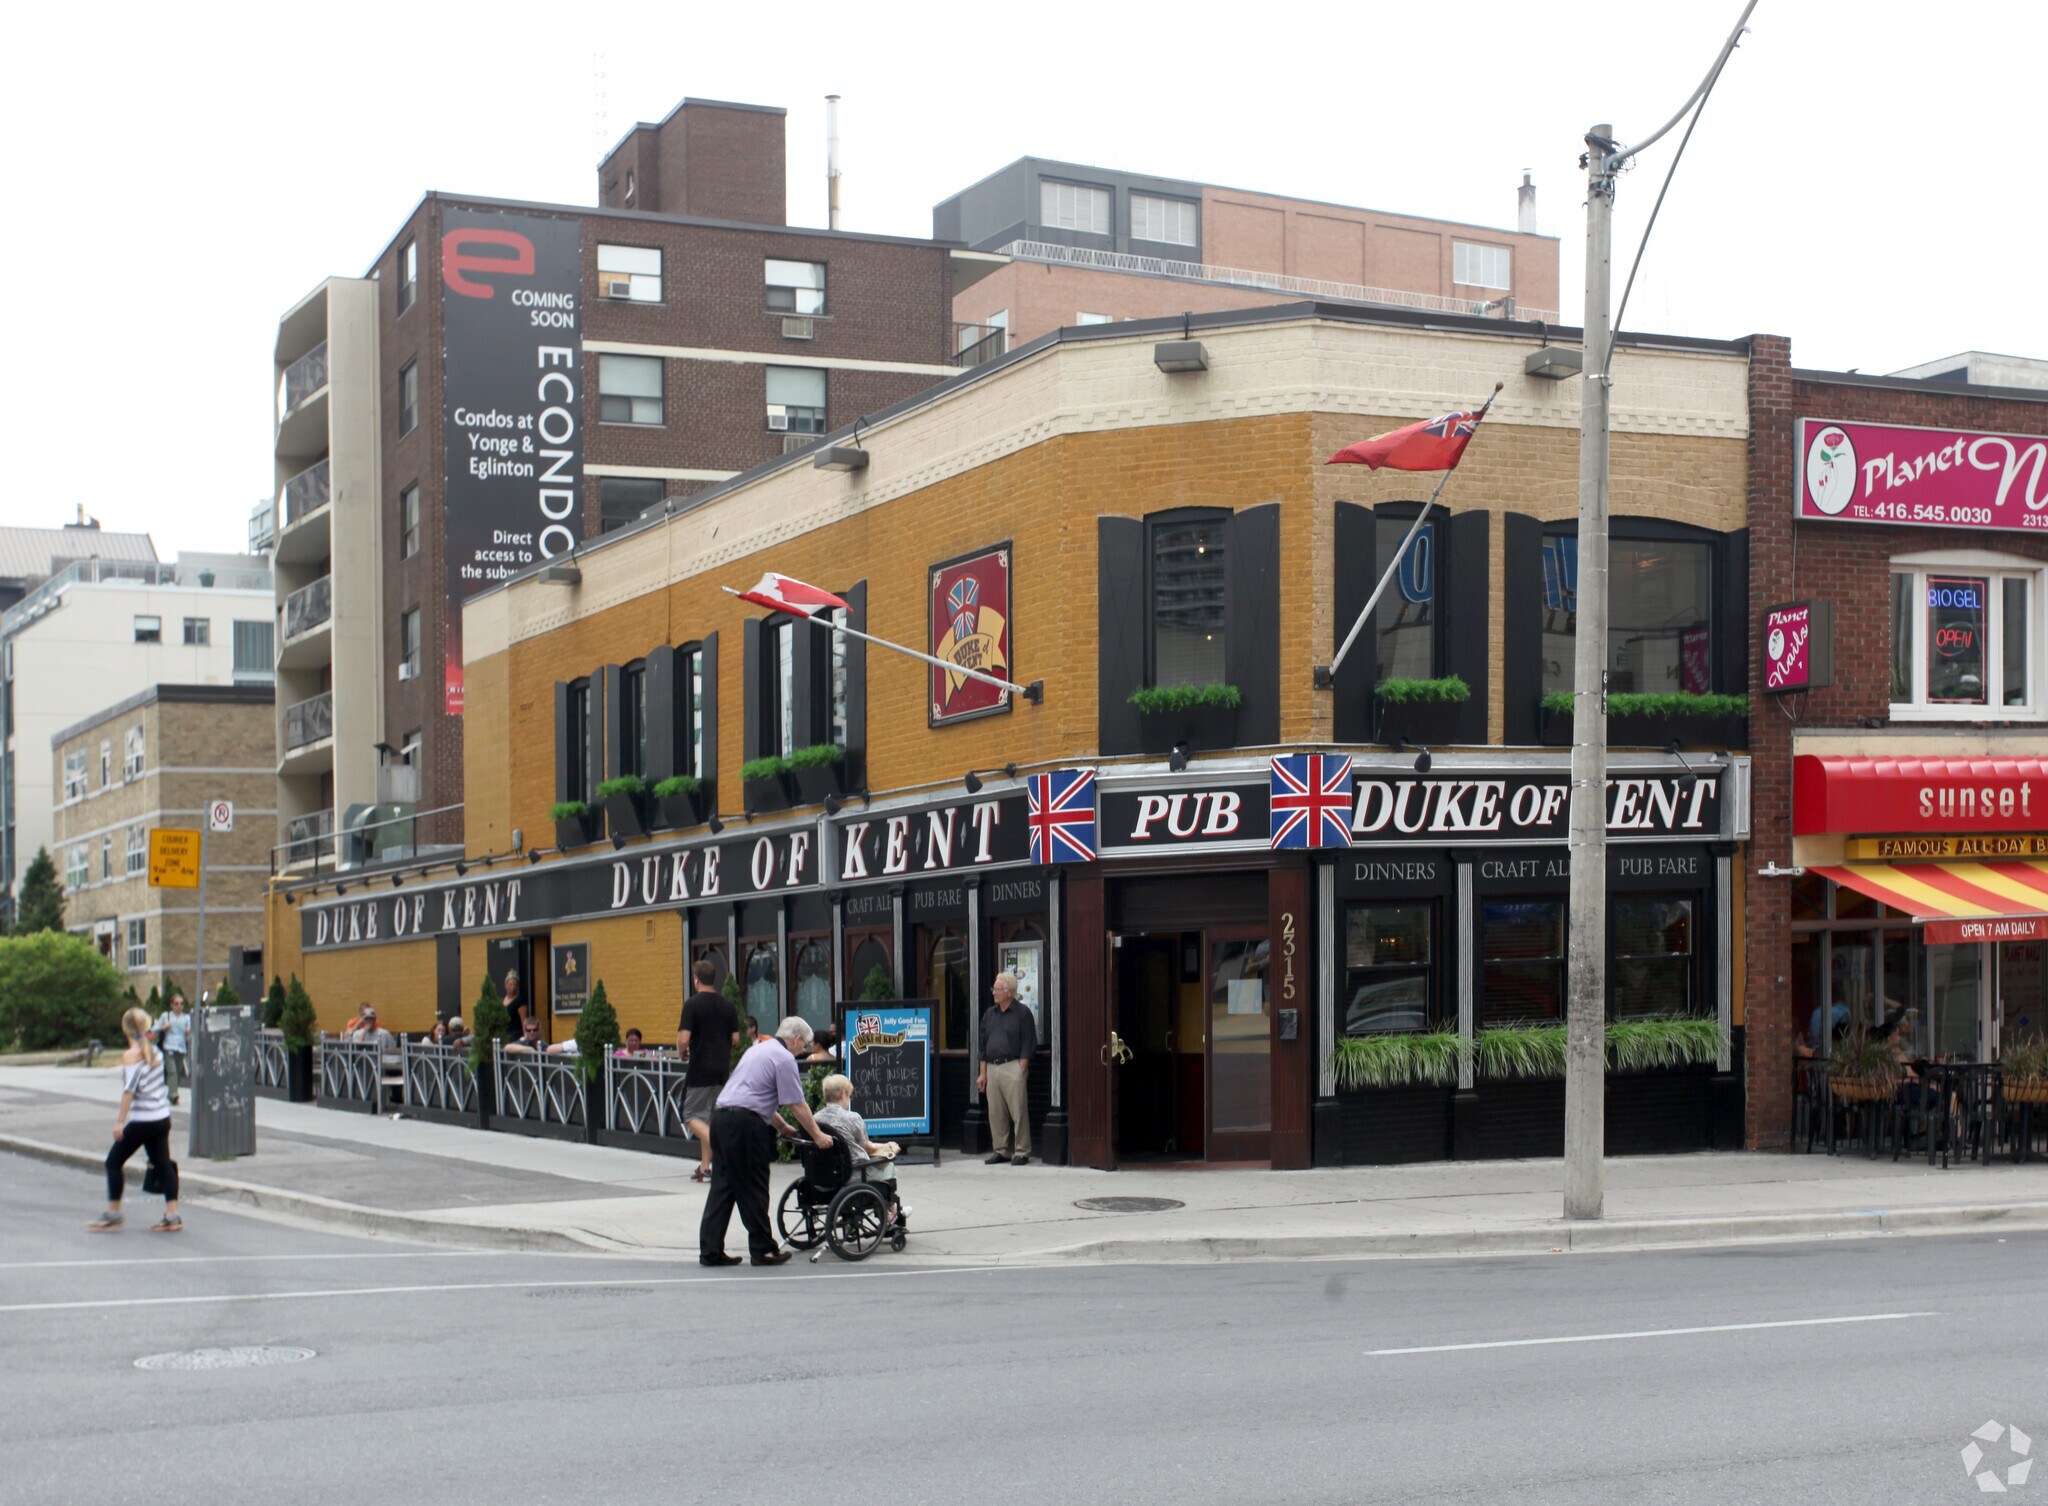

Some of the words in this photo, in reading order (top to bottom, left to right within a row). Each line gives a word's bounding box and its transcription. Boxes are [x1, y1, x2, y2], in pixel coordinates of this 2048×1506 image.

[512, 290, 574, 310] COMING
[531, 311, 574, 328] SOON
[454, 407, 513, 429] Condos
[518, 412, 533, 430] at
[468, 432, 516, 457] Yonge
[520, 436, 534, 454] &
[470, 456, 533, 479] Eglinton
[1862, 437, 1967, 498] Planet
[1854, 505, 1873, 518] TEL:
[1874, 502, 1992, 524] 416.545.0030
[493, 530, 533, 545] Direct
[475, 551, 515, 562] access
[518, 550, 533, 562] to
[461, 564, 482, 579] the
[1769, 609, 1808, 626] Planet
[1936, 629, 1973, 648] OPEN
[954, 639, 980, 665] DUKE
[1768, 624, 1808, 687] Nails
[1352, 780, 1505, 834] DUKE
[1510, 784, 1567, 828] OF
[1919, 781, 2031, 817] sunset
[1130, 791, 1242, 839] PUB
[160, 847, 188, 856] DELIVERY
[611, 845, 720, 909] DUKE
[751, 831, 809, 891] OF
[842, 800, 1001, 880] KENT
[1884, 840, 1950, 855] FAMOUS
[164, 859, 180, 867] ZONE
[1355, 862, 1436, 881] DINNERS
[1482, 860, 1540, 879] CRAFT
[1545, 859, 1571, 877] AL
[1620, 858, 1653, 876] PUB
[1658, 857, 1697, 875] FARE
[915, 892, 935, 909] PUB
[938, 888, 962, 907] FARE
[992, 880, 1041, 902] DINNERS
[316, 902, 377, 945] DUKE
[394, 894, 425, 936] OF
[442, 879, 521, 930] KENT
[847, 896, 874, 914] CRAFT
[876, 895, 892, 911] ALE
[1961, 923, 1985, 937] OPEN
[1987, 923, 1992, 936] 7
[1995, 922, 2010, 935] AM
[2011, 921, 2036, 934] DAILY
[1281, 912, 1296, 999] 2315
[883, 1035, 901, 1044] KENT
[855, 1068, 880, 1084] COME
[886, 1068, 919, 1081] INSIDE
[854, 1086, 871, 1097] FOR
[875, 1085, 882, 1095] A
[886, 1084, 919, 1098] FROSTY
[864, 1101, 895, 1115] PINT!
